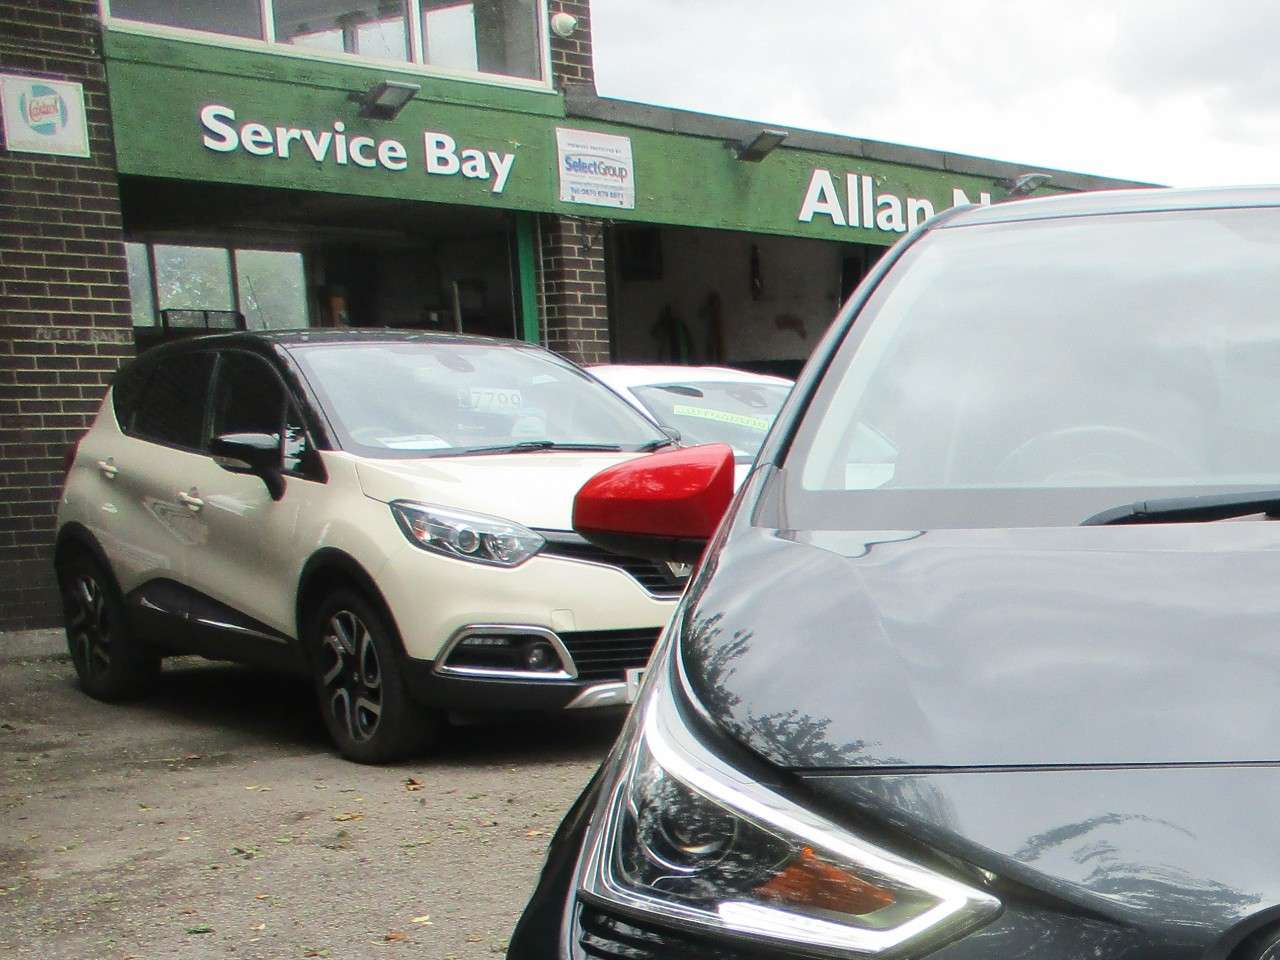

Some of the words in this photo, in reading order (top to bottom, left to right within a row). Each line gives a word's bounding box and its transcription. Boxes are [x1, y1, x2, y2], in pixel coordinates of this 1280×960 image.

[200, 104, 408, 171] Service
[424, 132, 516, 193] Bay
[564, 155, 628, 183] SelectGroup
[799, 169, 935, 232] Allan
